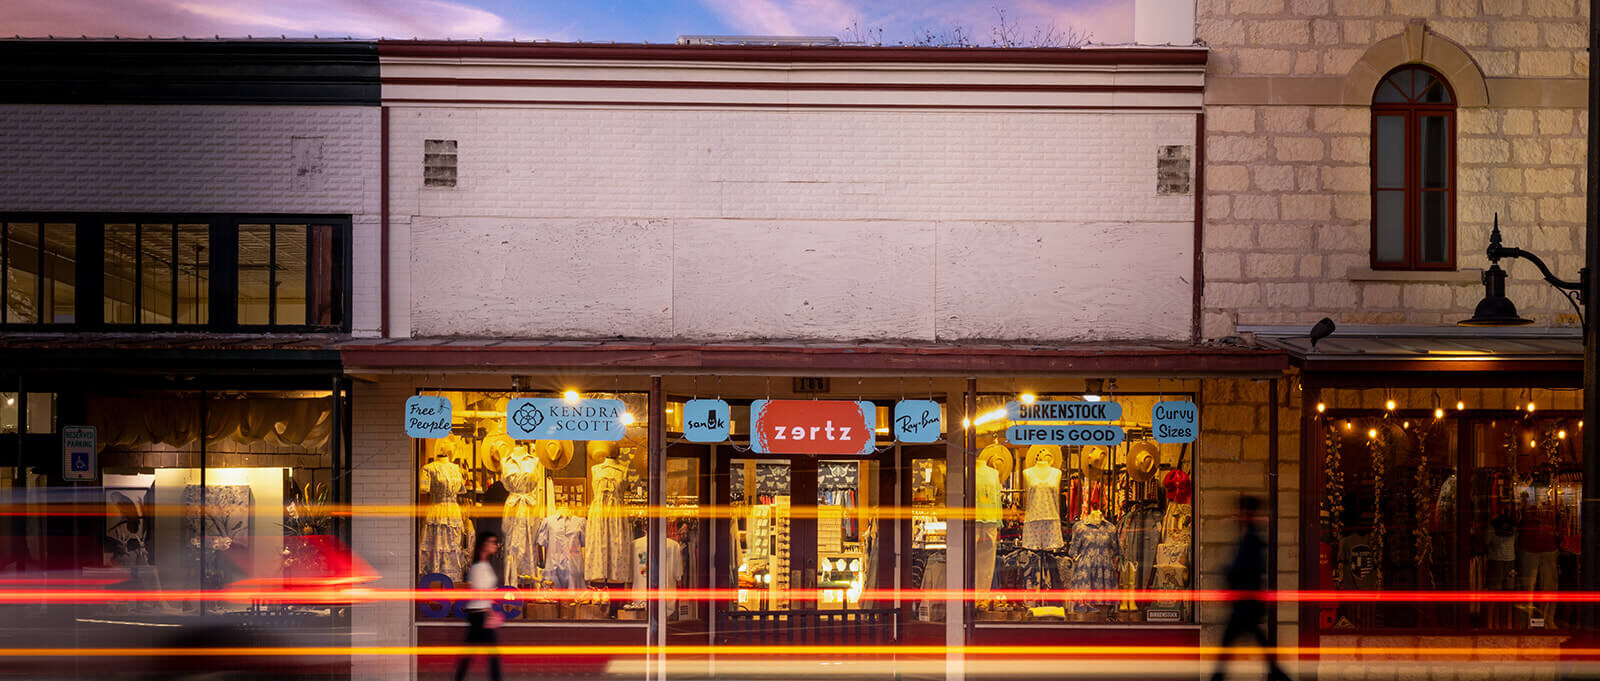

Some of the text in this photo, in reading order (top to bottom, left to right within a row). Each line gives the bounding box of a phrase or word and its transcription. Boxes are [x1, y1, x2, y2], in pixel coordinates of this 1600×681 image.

[409, 403, 436, 416] Free
[549, 406, 619, 418] KENDRA
[1019, 404, 1107, 419] BIRKENSTOCK
[1155, 406, 1194, 423] Curvy
[409, 417, 450, 433] People
[556, 419, 613, 432] SCOTT
[896, 410, 940, 433] Ray-Ban
[774, 420, 852, 440] zertz
[1051, 429, 1064, 441] IS
[1068, 429, 1115, 441] GOOD
[1158, 423, 1192, 438] Sizes
[67, 440, 93, 448] PARKING
